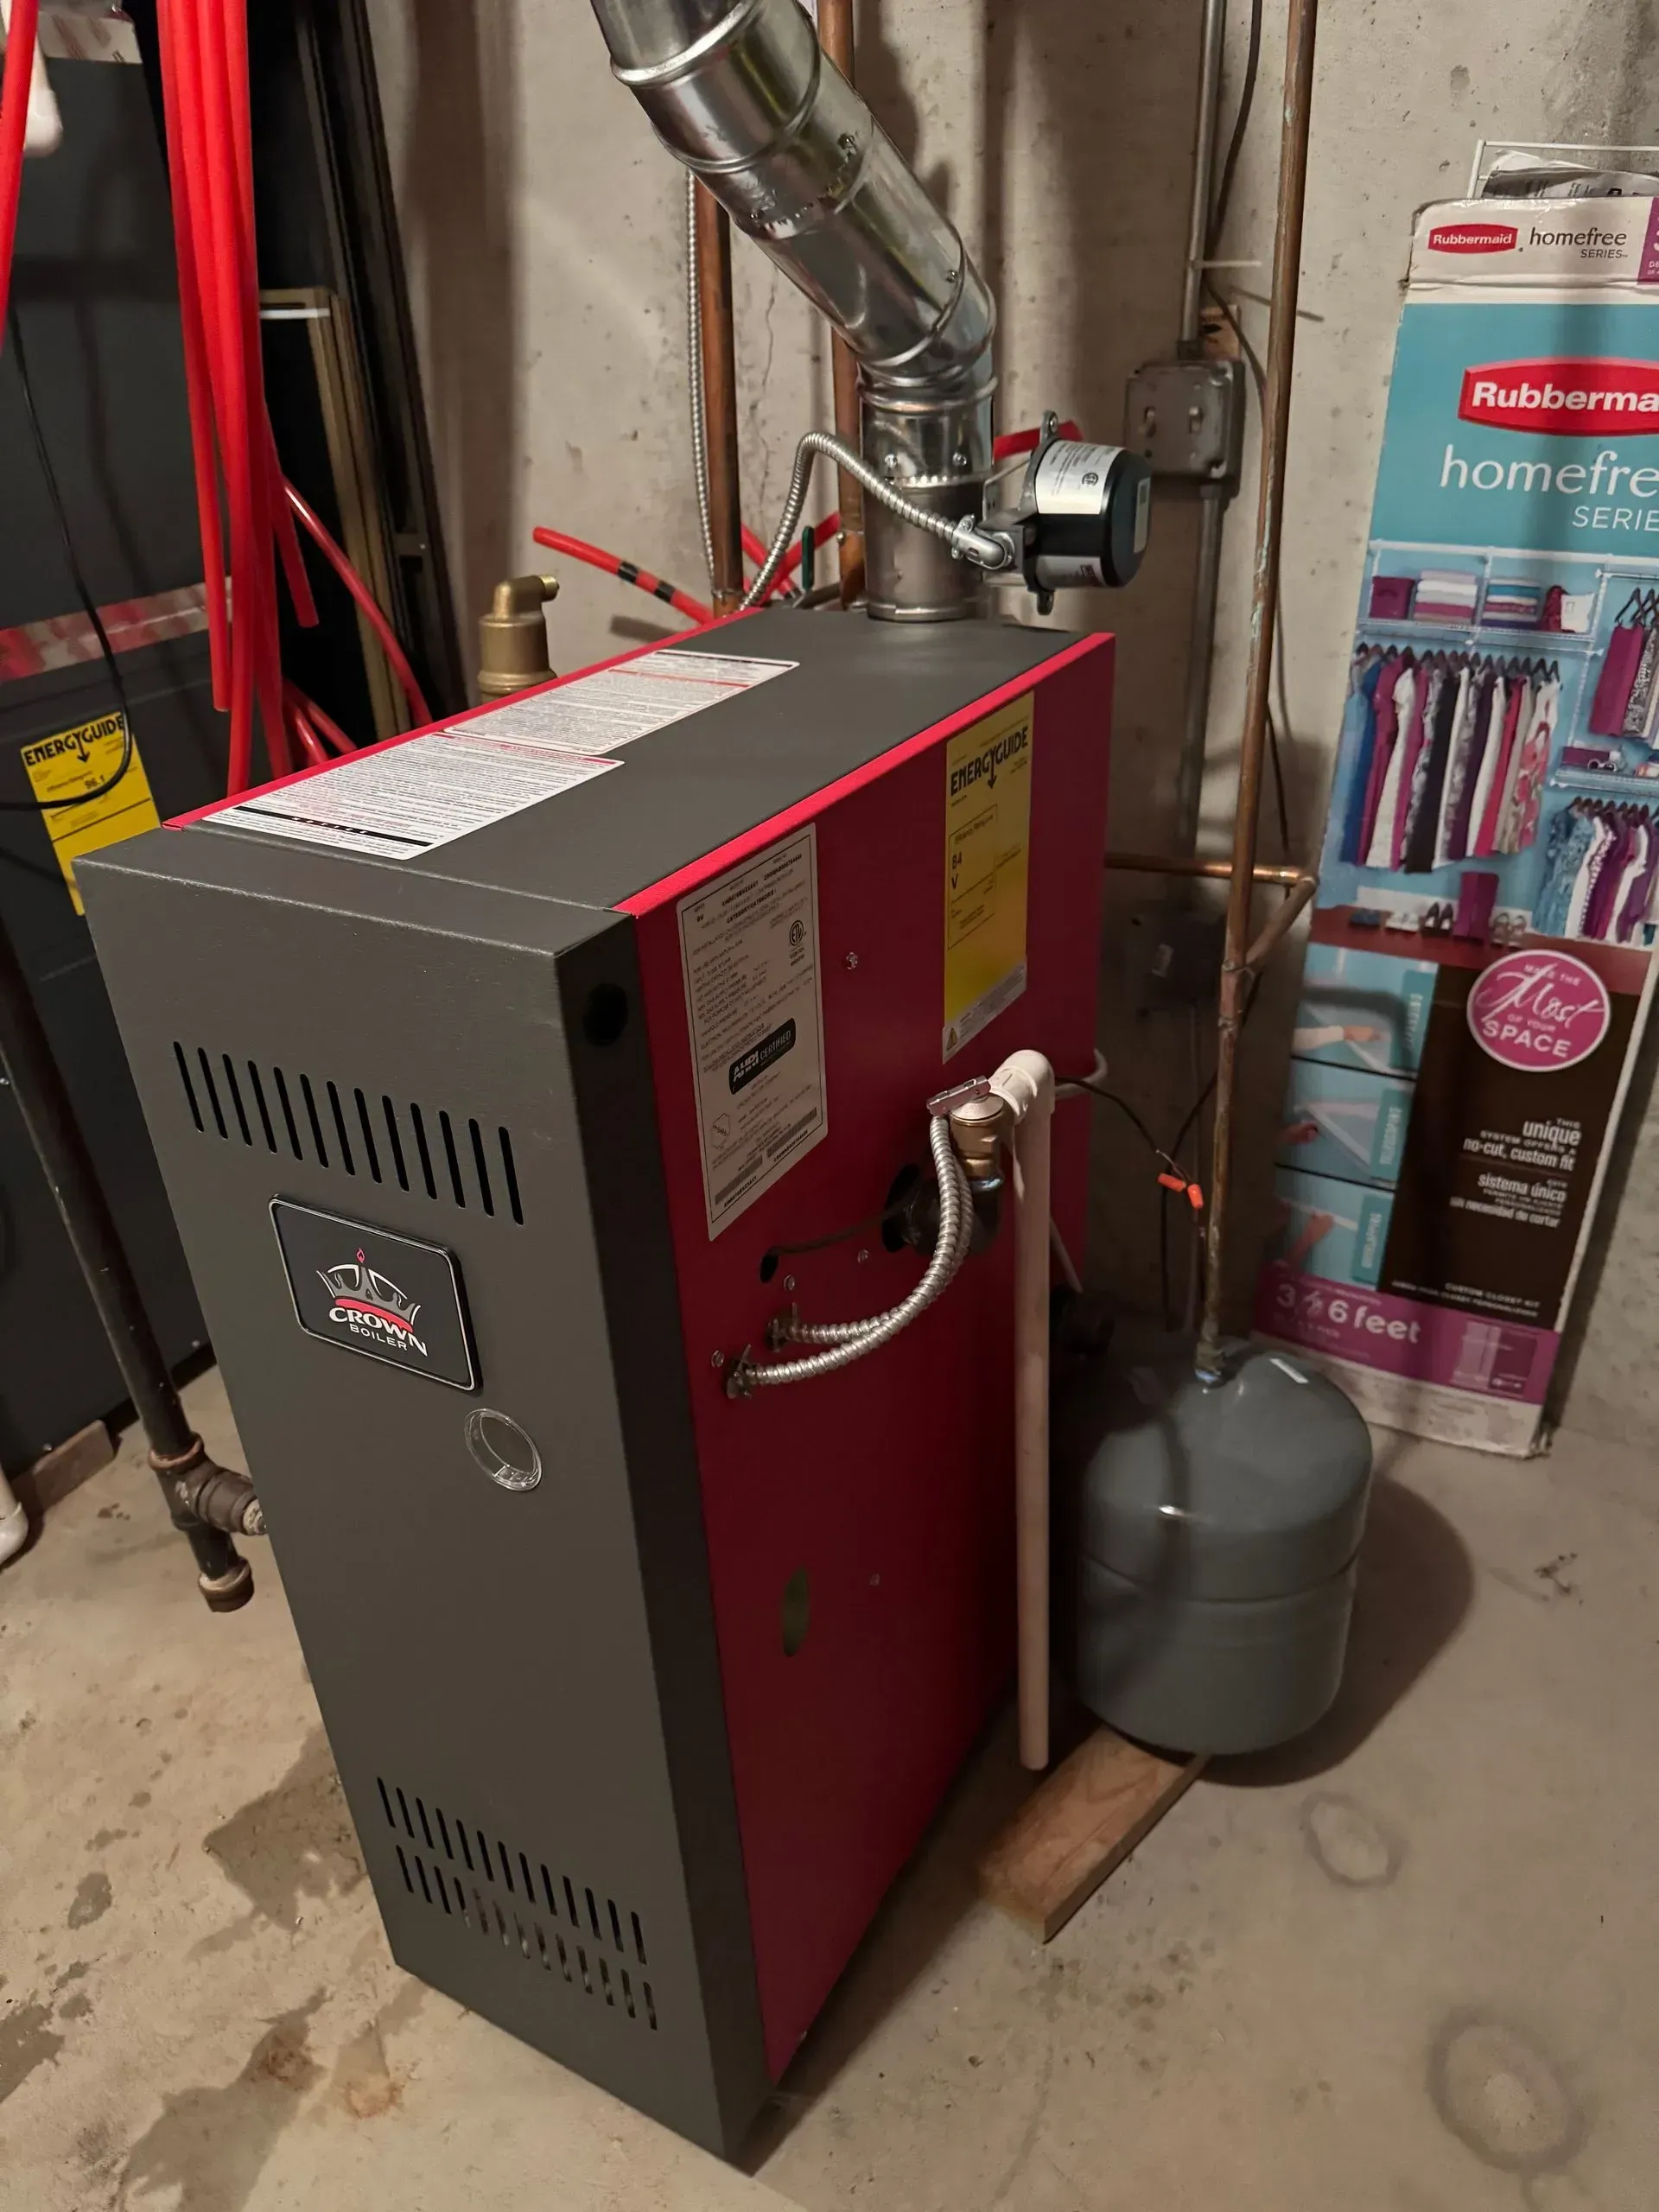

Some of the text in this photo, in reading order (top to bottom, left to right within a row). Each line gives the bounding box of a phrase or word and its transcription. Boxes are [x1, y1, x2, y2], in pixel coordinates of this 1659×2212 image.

[1433, 226, 1627, 246] Rubbermaid homefree
[1471, 380, 1659, 413] Rubberma
[1440, 443, 1659, 499] homefre
[1572, 505, 1659, 532] SERIE
[23, 715, 124, 766] ENERGYGUIDE
[950, 725, 1029, 797] ENERGYGUIDE
[1559, 973, 1581, 987] THE
[1482, 1020, 1572, 1058] SPACE
[1522, 1119, 1583, 1147] unique
[1463, 1137, 1576, 1172] no-cut, custom fit
[1477, 1173, 1529, 1195] sistema
[1275, 1283, 1297, 1309] 3
[1327, 1299, 1351, 1324] 6
[1352, 1304, 1422, 1345] feet
[328, 1306, 428, 1357] CROWN
[349, 1323, 408, 1351] BOILER
